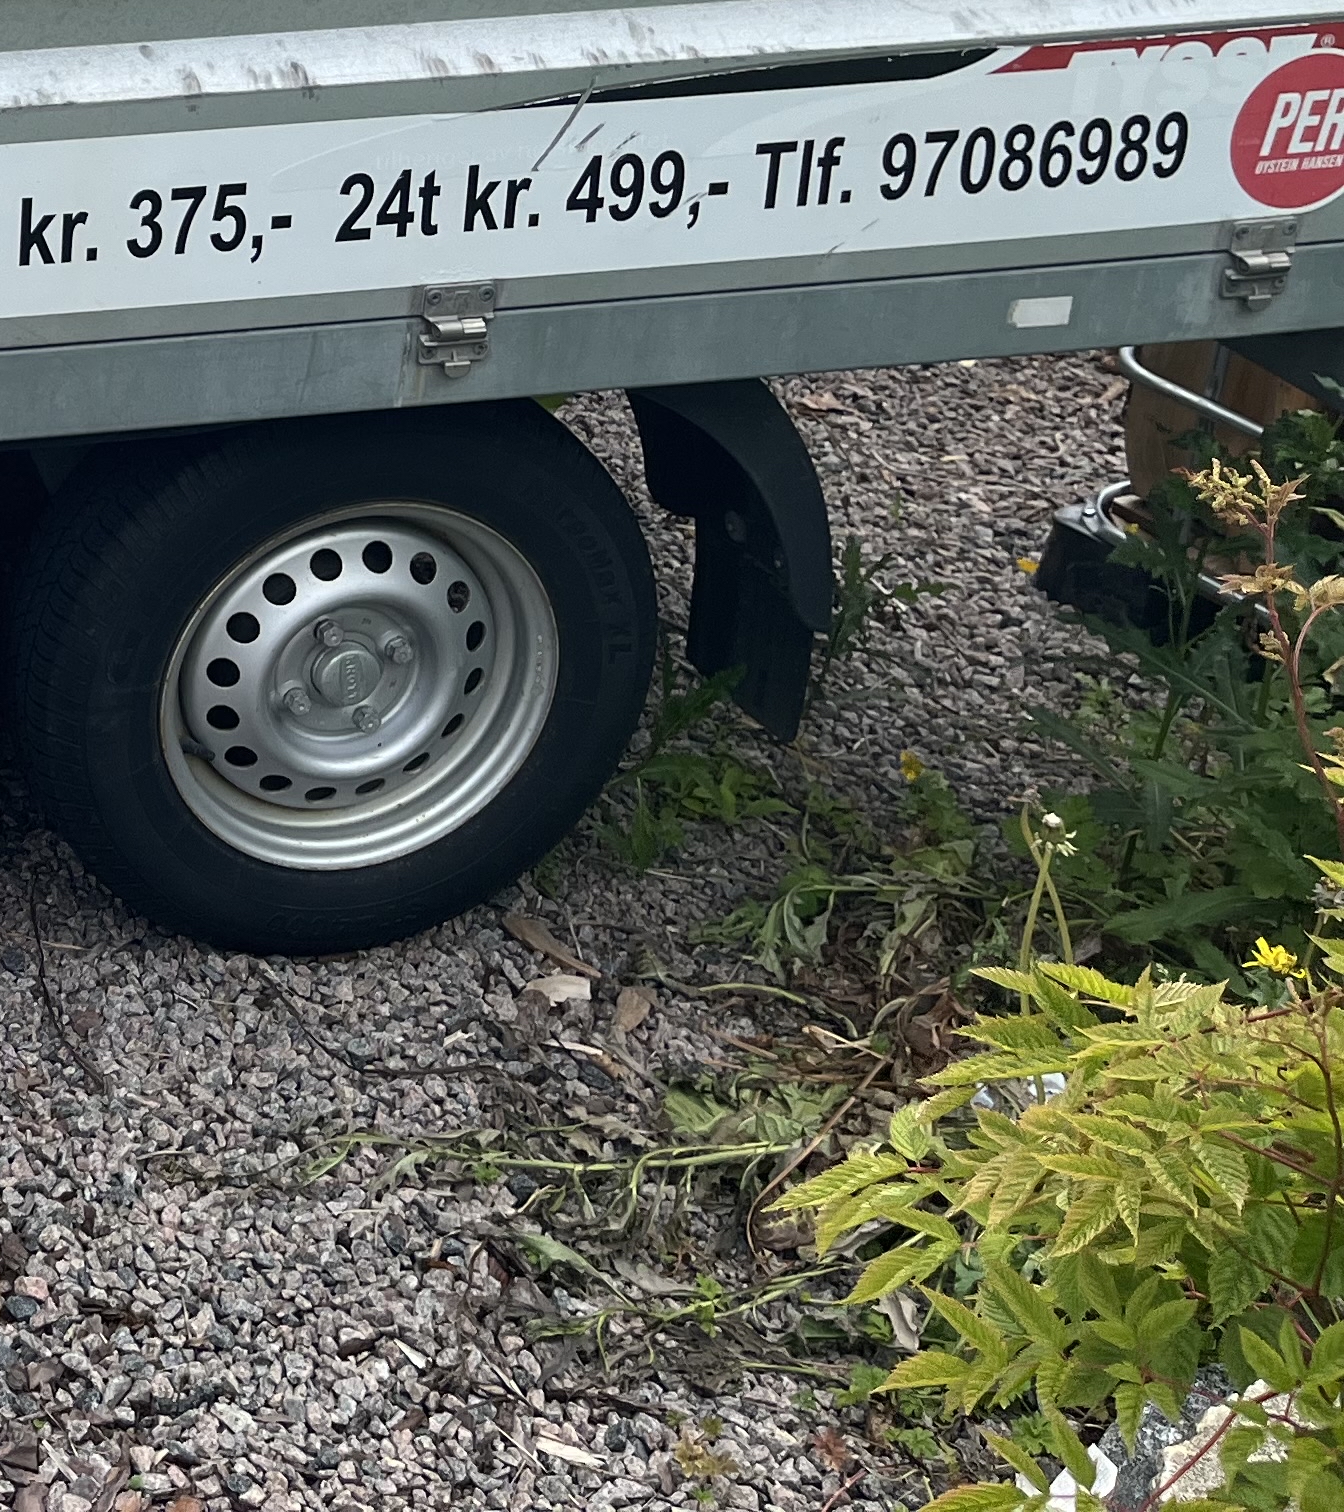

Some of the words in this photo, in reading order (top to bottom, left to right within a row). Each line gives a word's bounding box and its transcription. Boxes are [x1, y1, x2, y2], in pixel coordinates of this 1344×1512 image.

[1258, 88, 1344, 157] PER
[18, 197, 98, 267] kr.
[126, 182, 293, 264] 375,-
[334, 168, 443, 243] 24t
[463, 164, 540, 233] kr.
[565, 149, 729, 230] 499,-
[755, 136, 852, 210] Tlf.
[878, 111, 1189, 201] 97086989
